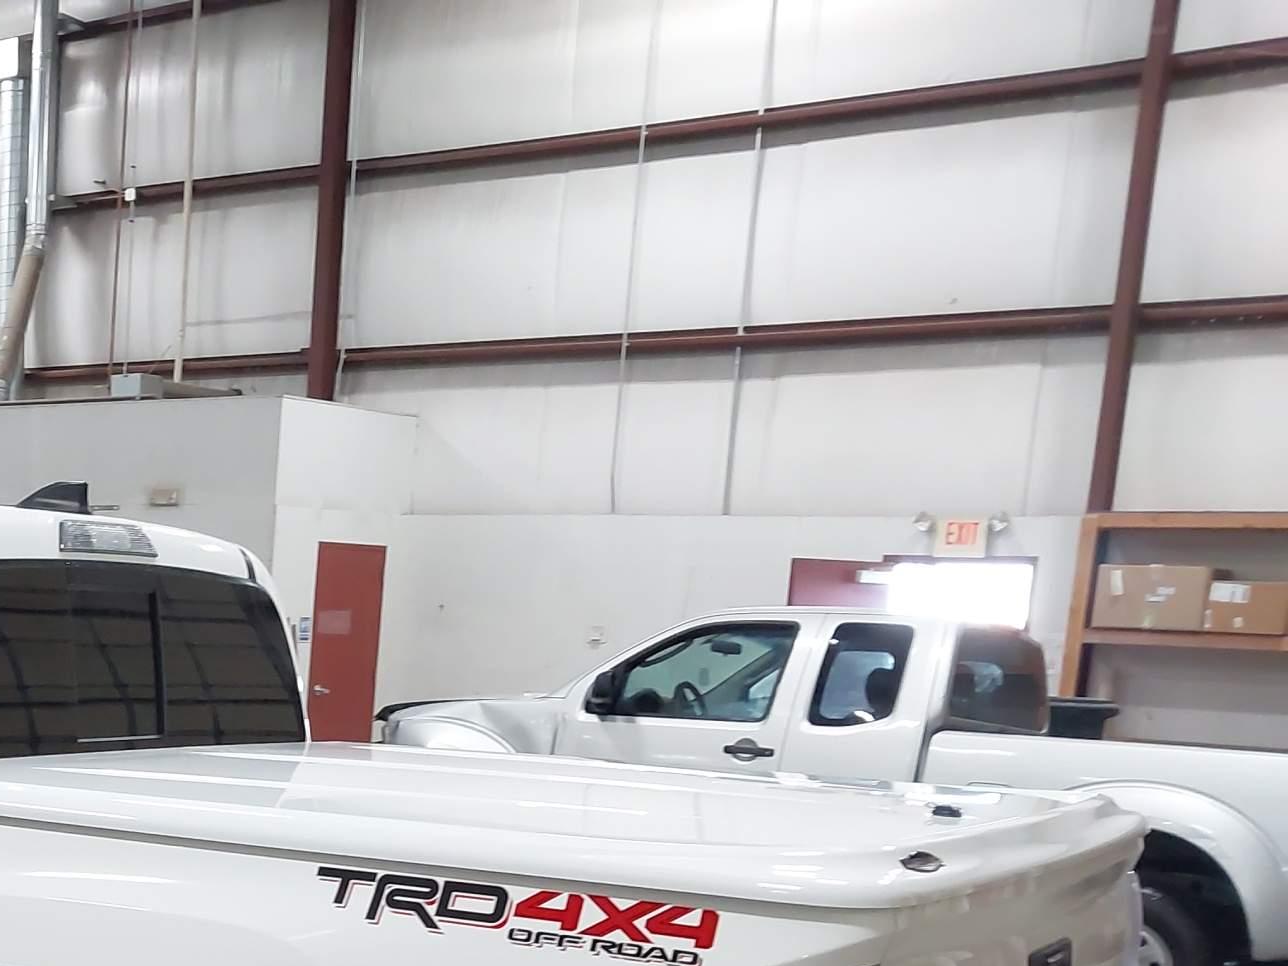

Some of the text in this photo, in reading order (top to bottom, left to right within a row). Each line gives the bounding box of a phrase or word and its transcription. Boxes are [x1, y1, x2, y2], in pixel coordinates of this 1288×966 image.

[945, 521, 978, 545] EXIT
[317, 865, 512, 934] TRD
[506, 927, 586, 952] OFF
